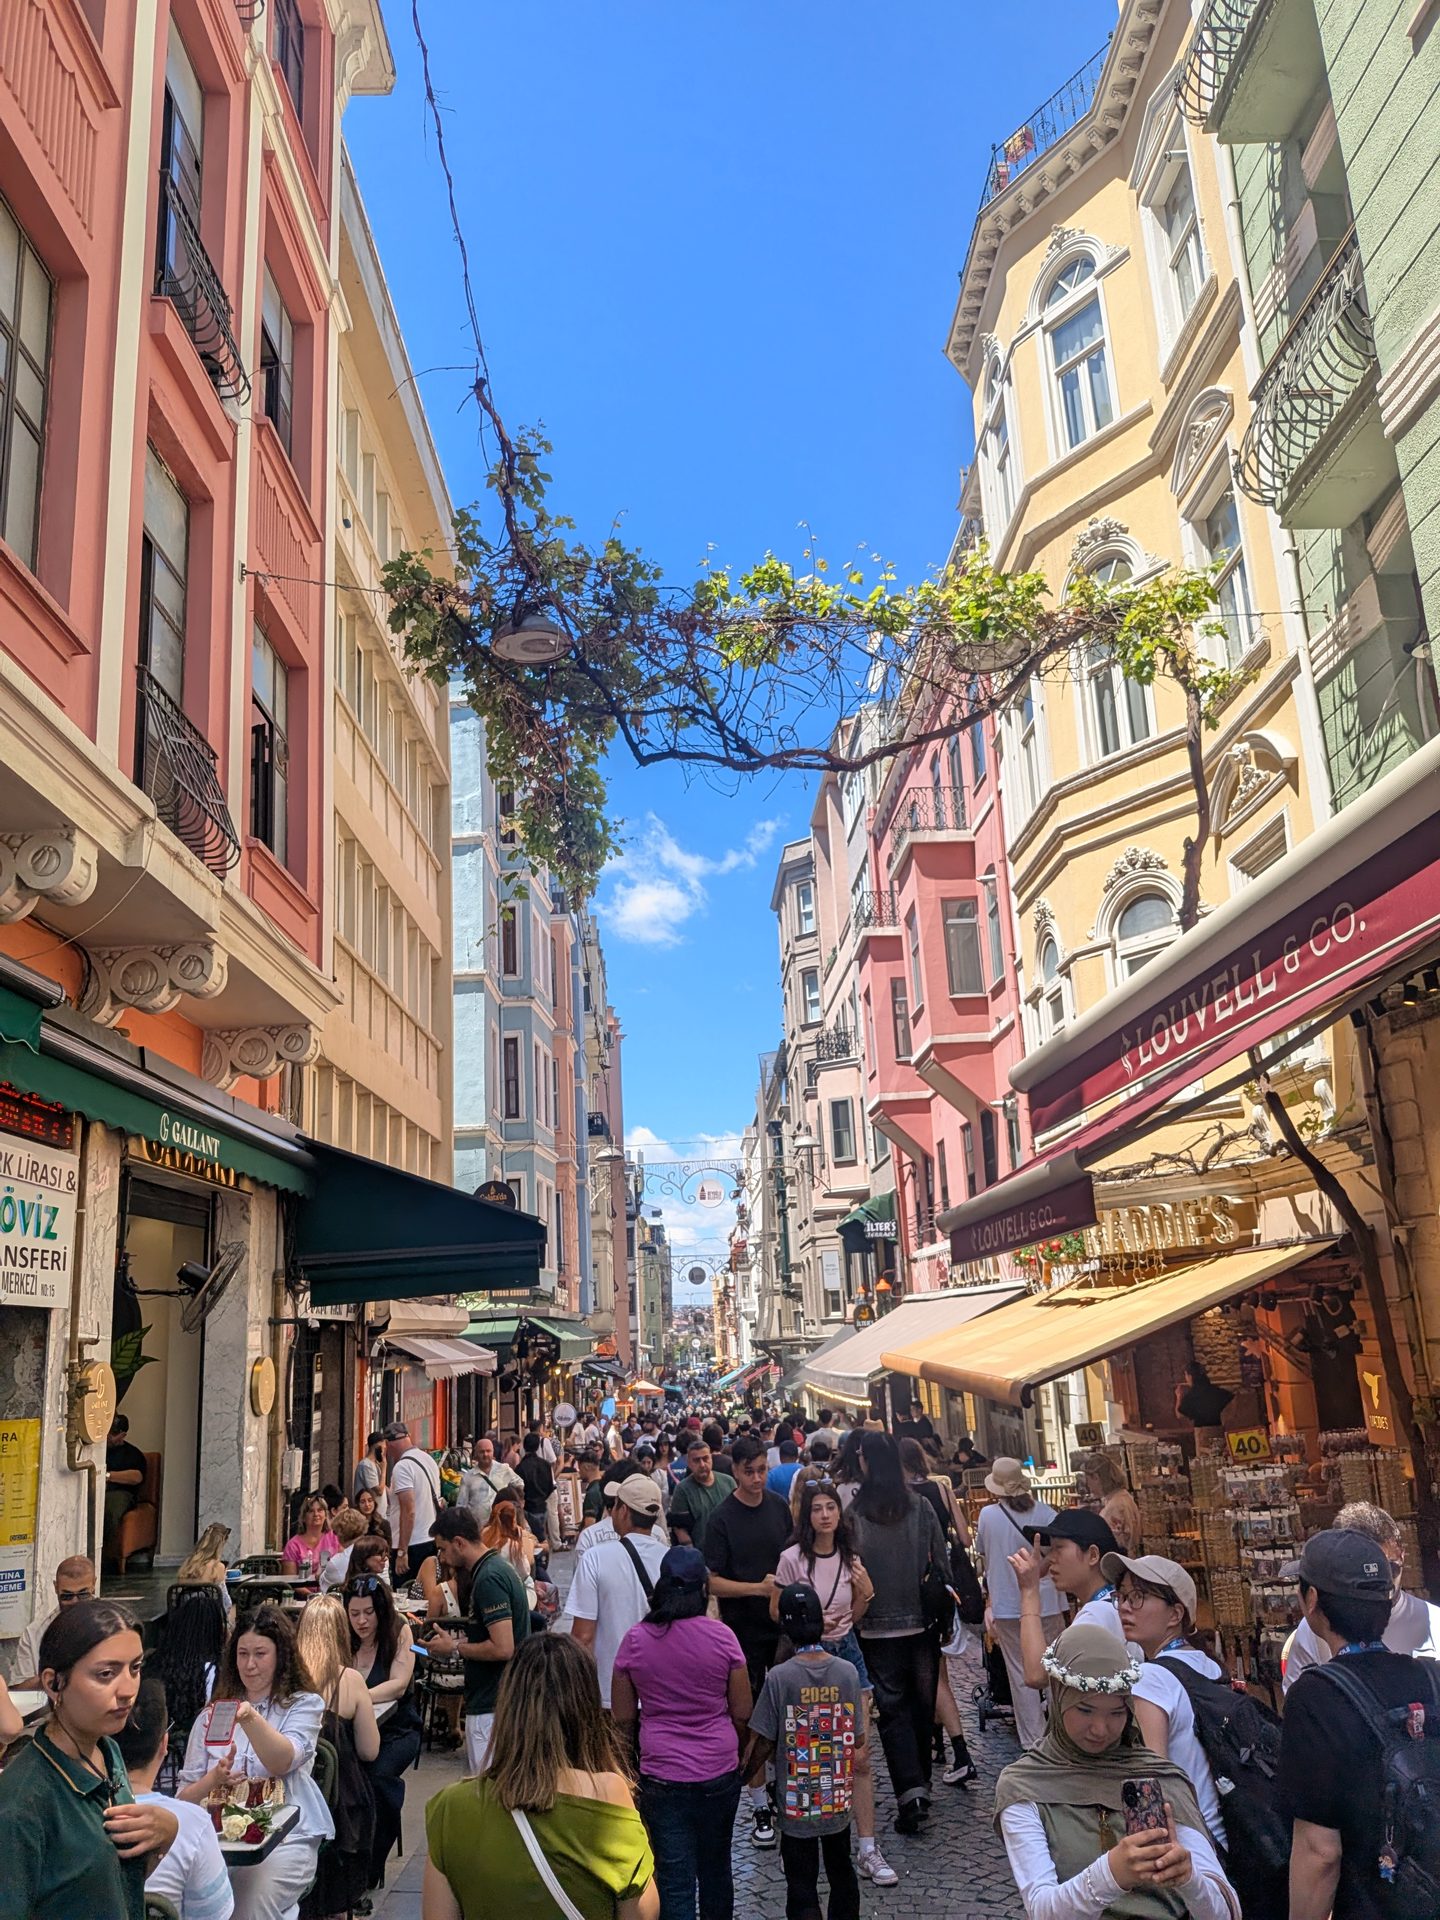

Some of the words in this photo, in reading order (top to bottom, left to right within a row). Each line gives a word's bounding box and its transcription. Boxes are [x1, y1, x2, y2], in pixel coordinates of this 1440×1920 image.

[1136, 949, 1277, 1067] LOUVELL
[1283, 935, 1300, 974] &
[1309, 902, 1366, 957] CO.
[172, 1121, 220, 1158] GALLANT
[17, 1153, 62, 1188] LİRASI
[66, 1170, 76, 1192] &
[0, 1185, 59, 1241] ÖVİZ
[977, 1211, 1030, 1251] LOUVELL
[1029, 1211, 1037, 1231] &
[1037, 1205, 1056, 1228] CO.
[1083, 1194, 1240, 1257] MADDIE'S
[0, 1245, 67, 1272] NSFERİ
[1, 1270, 38, 1296] MERKEZİ
[1080, 1428, 1097, 1442] 40
[1235, 1435, 1261, 1456] 40
[799, 1686, 841, 1704] 2026
